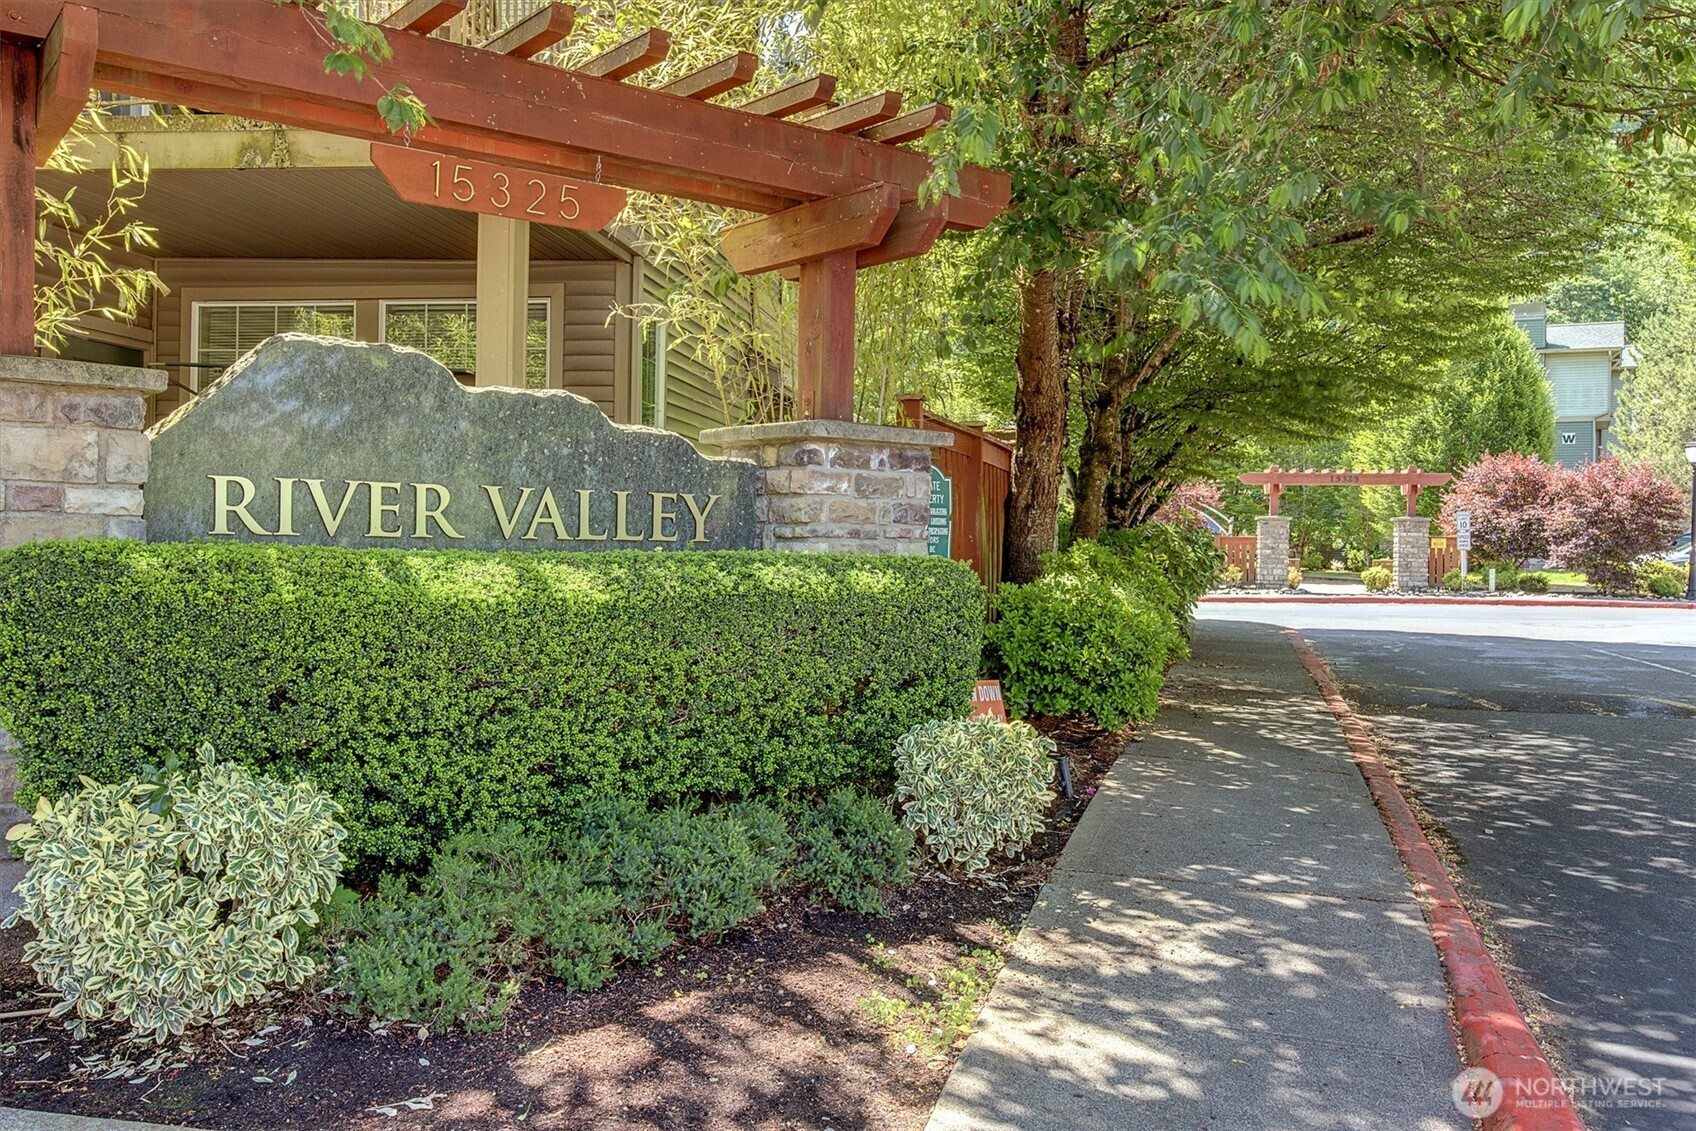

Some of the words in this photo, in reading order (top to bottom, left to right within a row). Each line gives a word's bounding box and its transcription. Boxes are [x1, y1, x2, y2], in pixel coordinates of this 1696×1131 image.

[432, 160, 580, 220] 15325
[1562, 434, 1576, 444] W
[1330, 474, 1359, 483] 15325
[207, 474, 465, 539] RIVER
[481, 485, 722, 543] VALLEY
[978, 686, 1002, 702] DOWN
